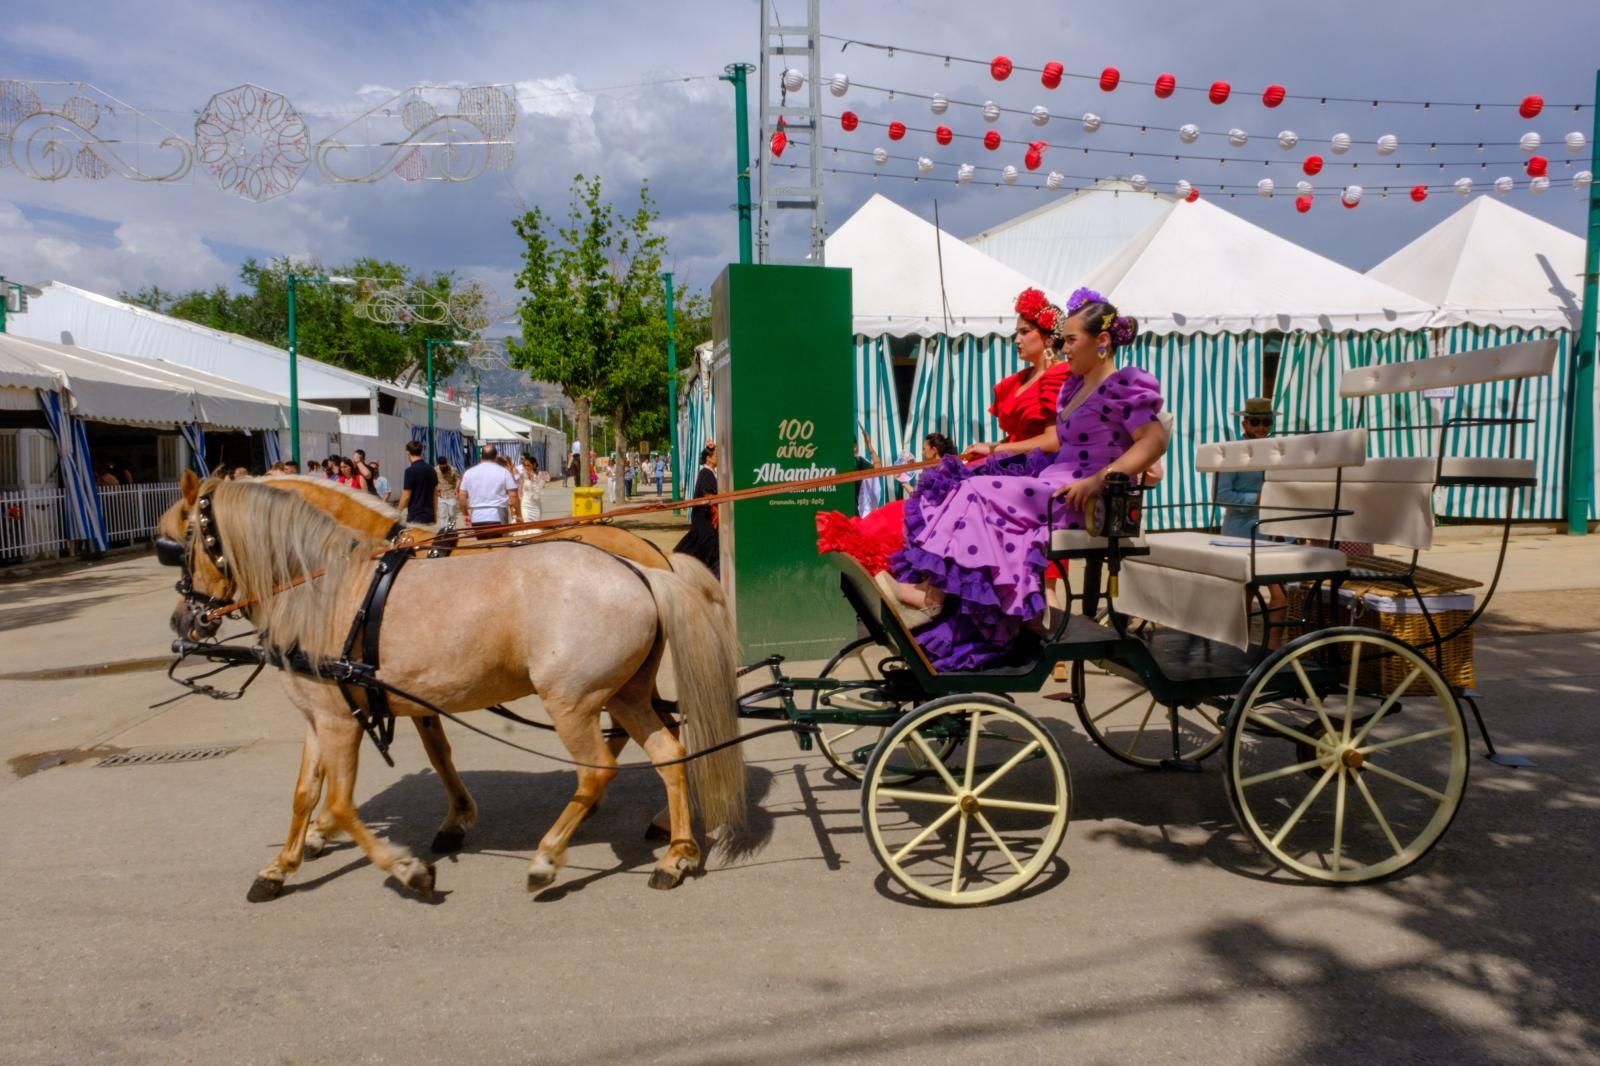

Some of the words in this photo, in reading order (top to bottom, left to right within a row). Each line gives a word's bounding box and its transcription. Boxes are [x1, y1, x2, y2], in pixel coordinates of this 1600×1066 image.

[778, 418, 815, 441] 100
[776, 441, 819, 459] años
[752, 462, 837, 485] Alhambra
[818, 485, 837, 493] PRISA
